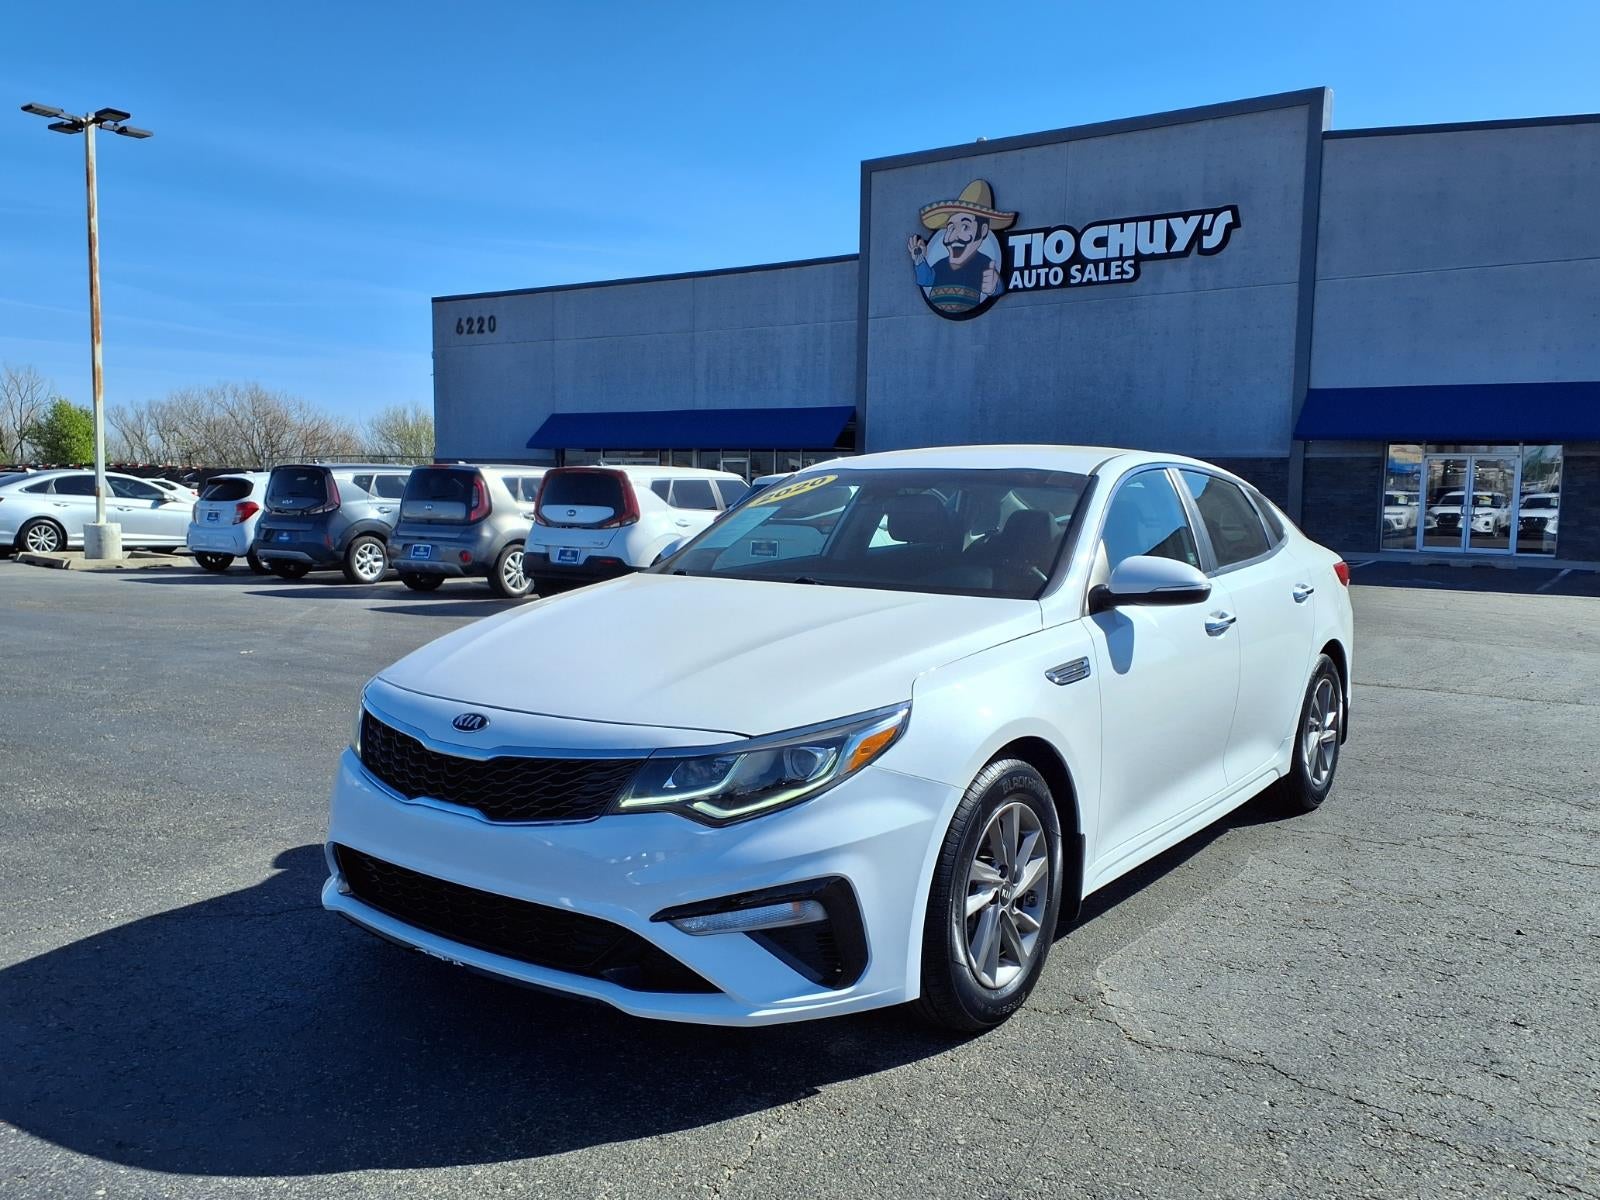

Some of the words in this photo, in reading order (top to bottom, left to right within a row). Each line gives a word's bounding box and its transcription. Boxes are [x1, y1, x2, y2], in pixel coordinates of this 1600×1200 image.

[1008, 229, 1076, 268] TIO
[1080, 210, 1233, 259] CHUY'S
[1008, 267, 1064, 290] AUTO
[1070, 260, 1135, 284] SALES
[456, 315, 496, 335] 6220
[755, 477, 828, 504] 2020
[455, 714, 482, 729] KIA
